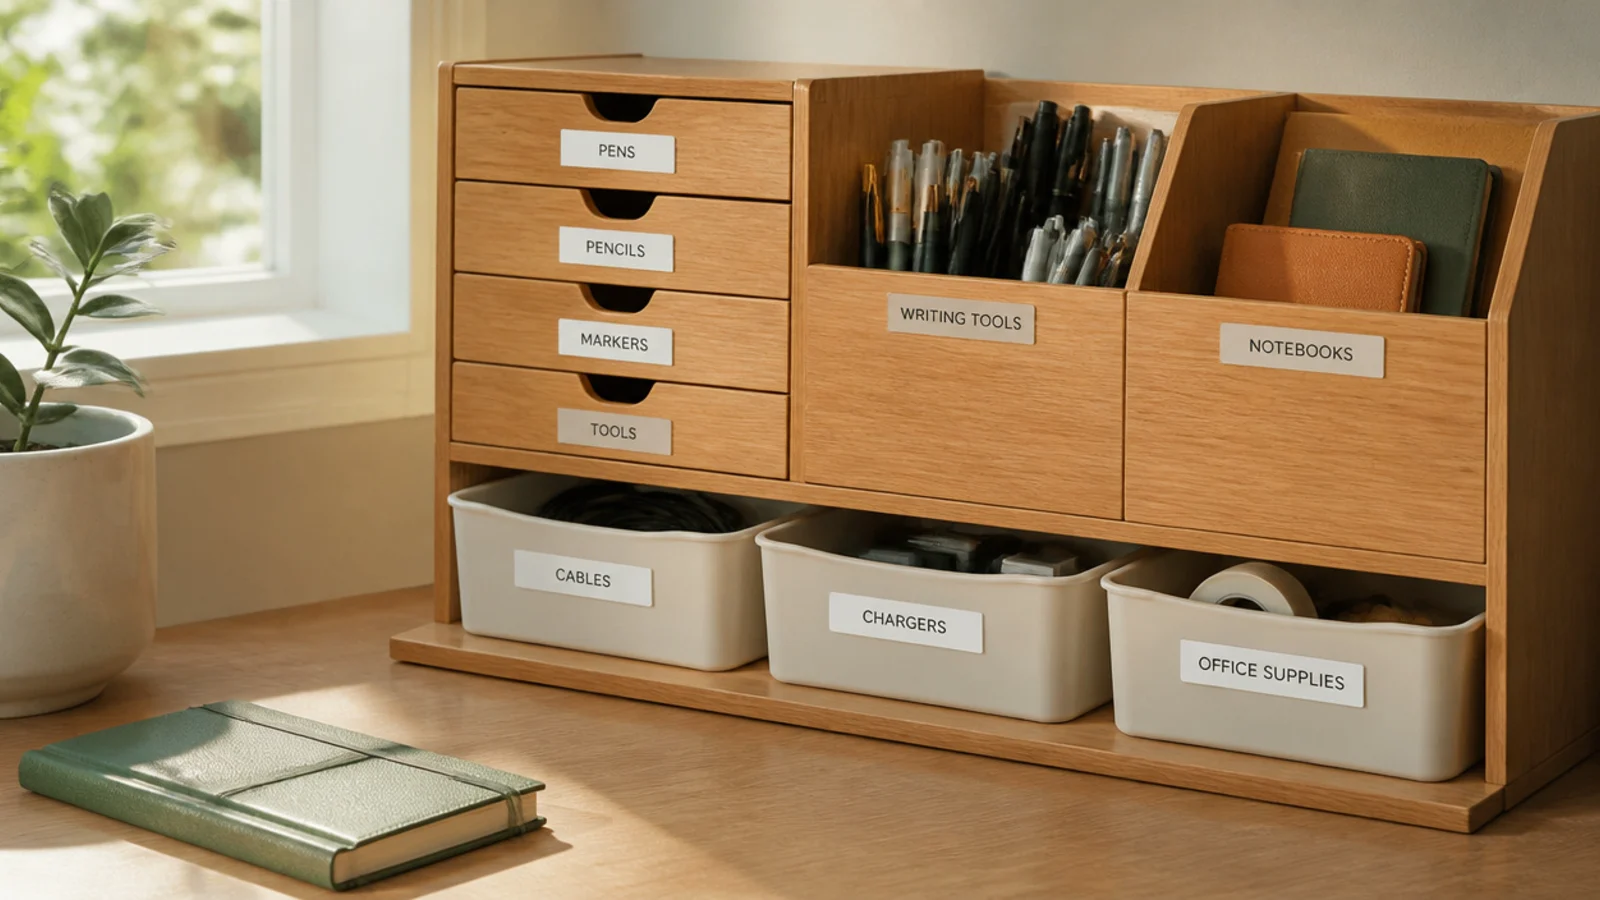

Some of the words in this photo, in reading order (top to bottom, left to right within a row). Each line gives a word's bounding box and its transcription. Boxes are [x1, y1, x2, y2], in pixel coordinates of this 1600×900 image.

[598, 144, 636, 160] PENS
[586, 240, 646, 257] PENCILS
[900, 307, 966, 326] WRITING
[971, 313, 1022, 331] TOOLS
[580, 333, 649, 353] MARKERS
[1249, 339, 1354, 362] NOTEBOOKS
[590, 423, 637, 440] TOOLS
[555, 568, 611, 588] CABLES
[862, 610, 947, 635] CHARGERS
[1198, 657, 1258, 679] OFFICE
[1263, 664, 1346, 691] SUPPLIES
